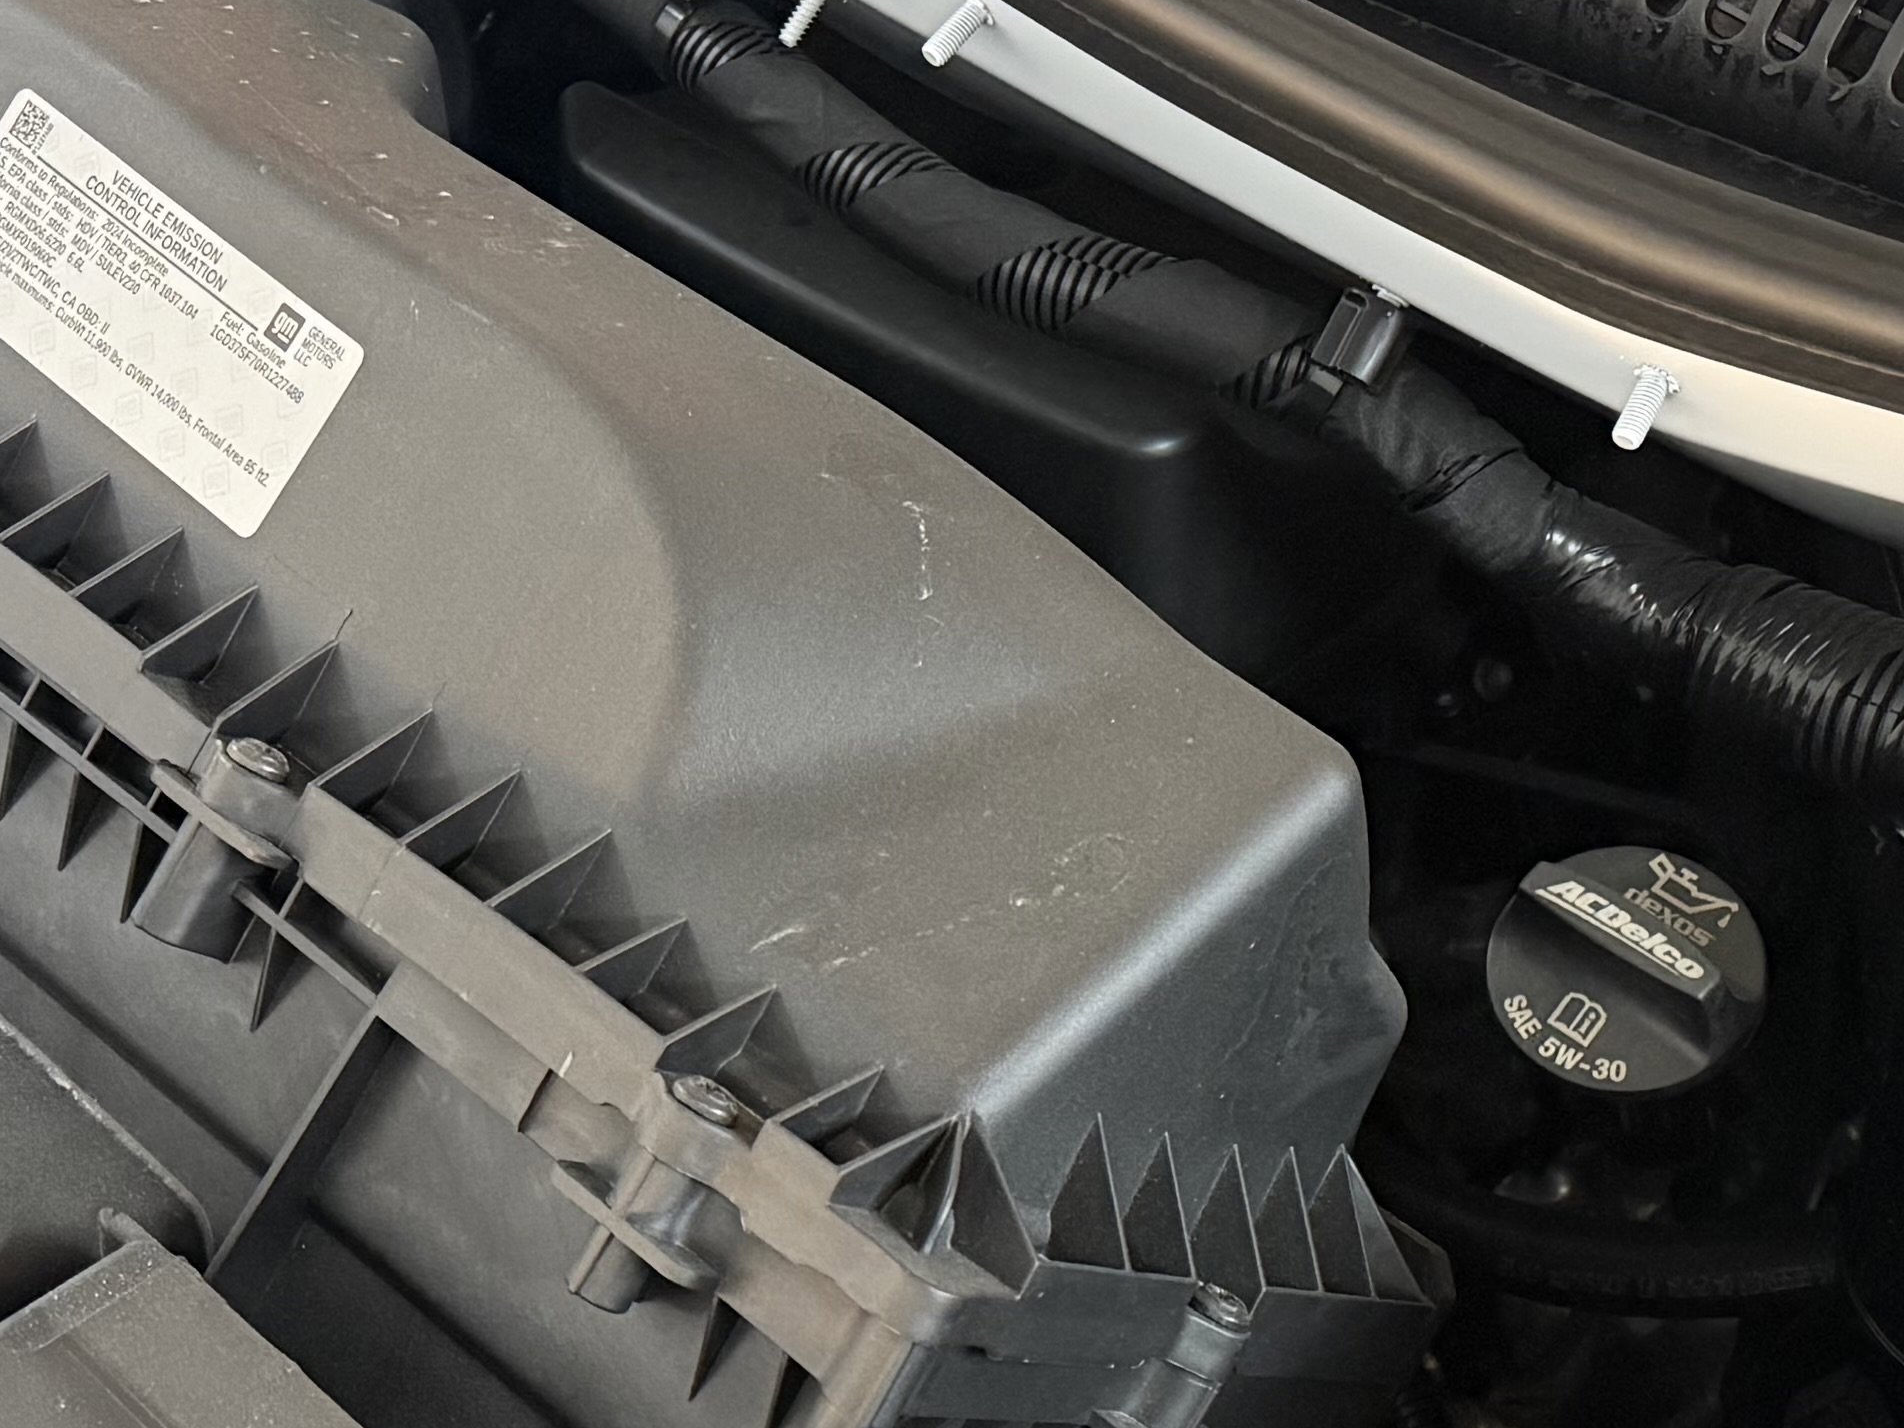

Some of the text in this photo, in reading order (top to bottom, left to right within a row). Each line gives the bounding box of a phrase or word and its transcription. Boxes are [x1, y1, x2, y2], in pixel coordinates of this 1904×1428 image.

[6, 162, 29, 184] EPA
[24, 176, 51, 202] class
[50, 198, 77, 222] stds:
[74, 217, 98, 239] HDV
[137, 267, 162, 291] CFR
[157, 283, 200, 320] 1037.104
[18, 192, 45, 217] class
[45, 214, 71, 238] stds:
[69, 233, 94, 257] MDV
[36, 168, 49, 181] to
[44, 174, 102, 223] Regulations:
[100, 217, 126, 241] 2024
[118, 233, 171, 279] Incomplete
[83, 173, 229, 292] CONTROL INFORMATION
[107, 169, 224, 265] VEHICLE EMISSION
[64, 251, 88, 273] 6.6L
[59, 289, 79, 309] CA
[73, 301, 104, 329] OBD:
[218, 310, 289, 370] Fuel: Gasoline
[306, 325, 348, 361] GENERAL
[9, 272, 57, 313] maximums:
[52, 305, 88, 337] CurbWt
[106, 349, 129, 372] lbs,
[122, 362, 155, 391] GVWR
[148, 383, 182, 414] 14,000
[174, 404, 198, 427] lbs,
[190, 417, 227, 450] Frontal
[221, 442, 247, 466] Area
[207, 323, 306, 404] 1GD37SF70R1227488
[291, 348, 313, 368] LLC
[299, 336, 337, 370] MOTORS
[1546, 880, 1704, 979] ACDelco
[1623, 887, 1716, 948] dexos
[1504, 994, 1627, 1083] SAE 5W-30
